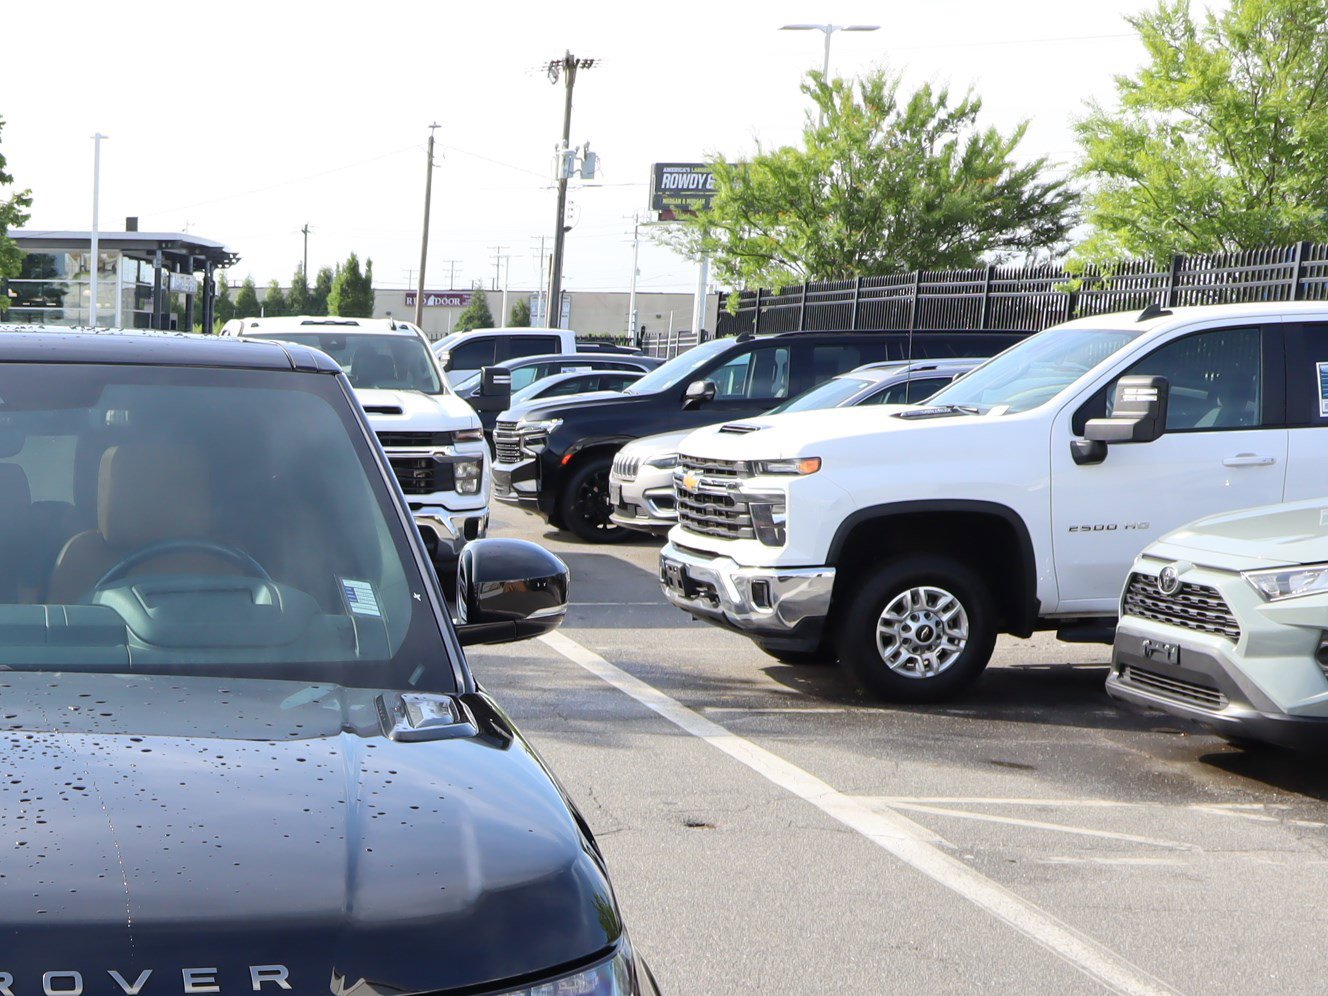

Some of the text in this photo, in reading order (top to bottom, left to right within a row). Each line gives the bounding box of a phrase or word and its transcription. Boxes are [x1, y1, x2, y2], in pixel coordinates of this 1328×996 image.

[661, 173, 705, 189] ROWDY
[435, 297, 461, 306] DOOR
[1068, 523, 1118, 533] 2500
